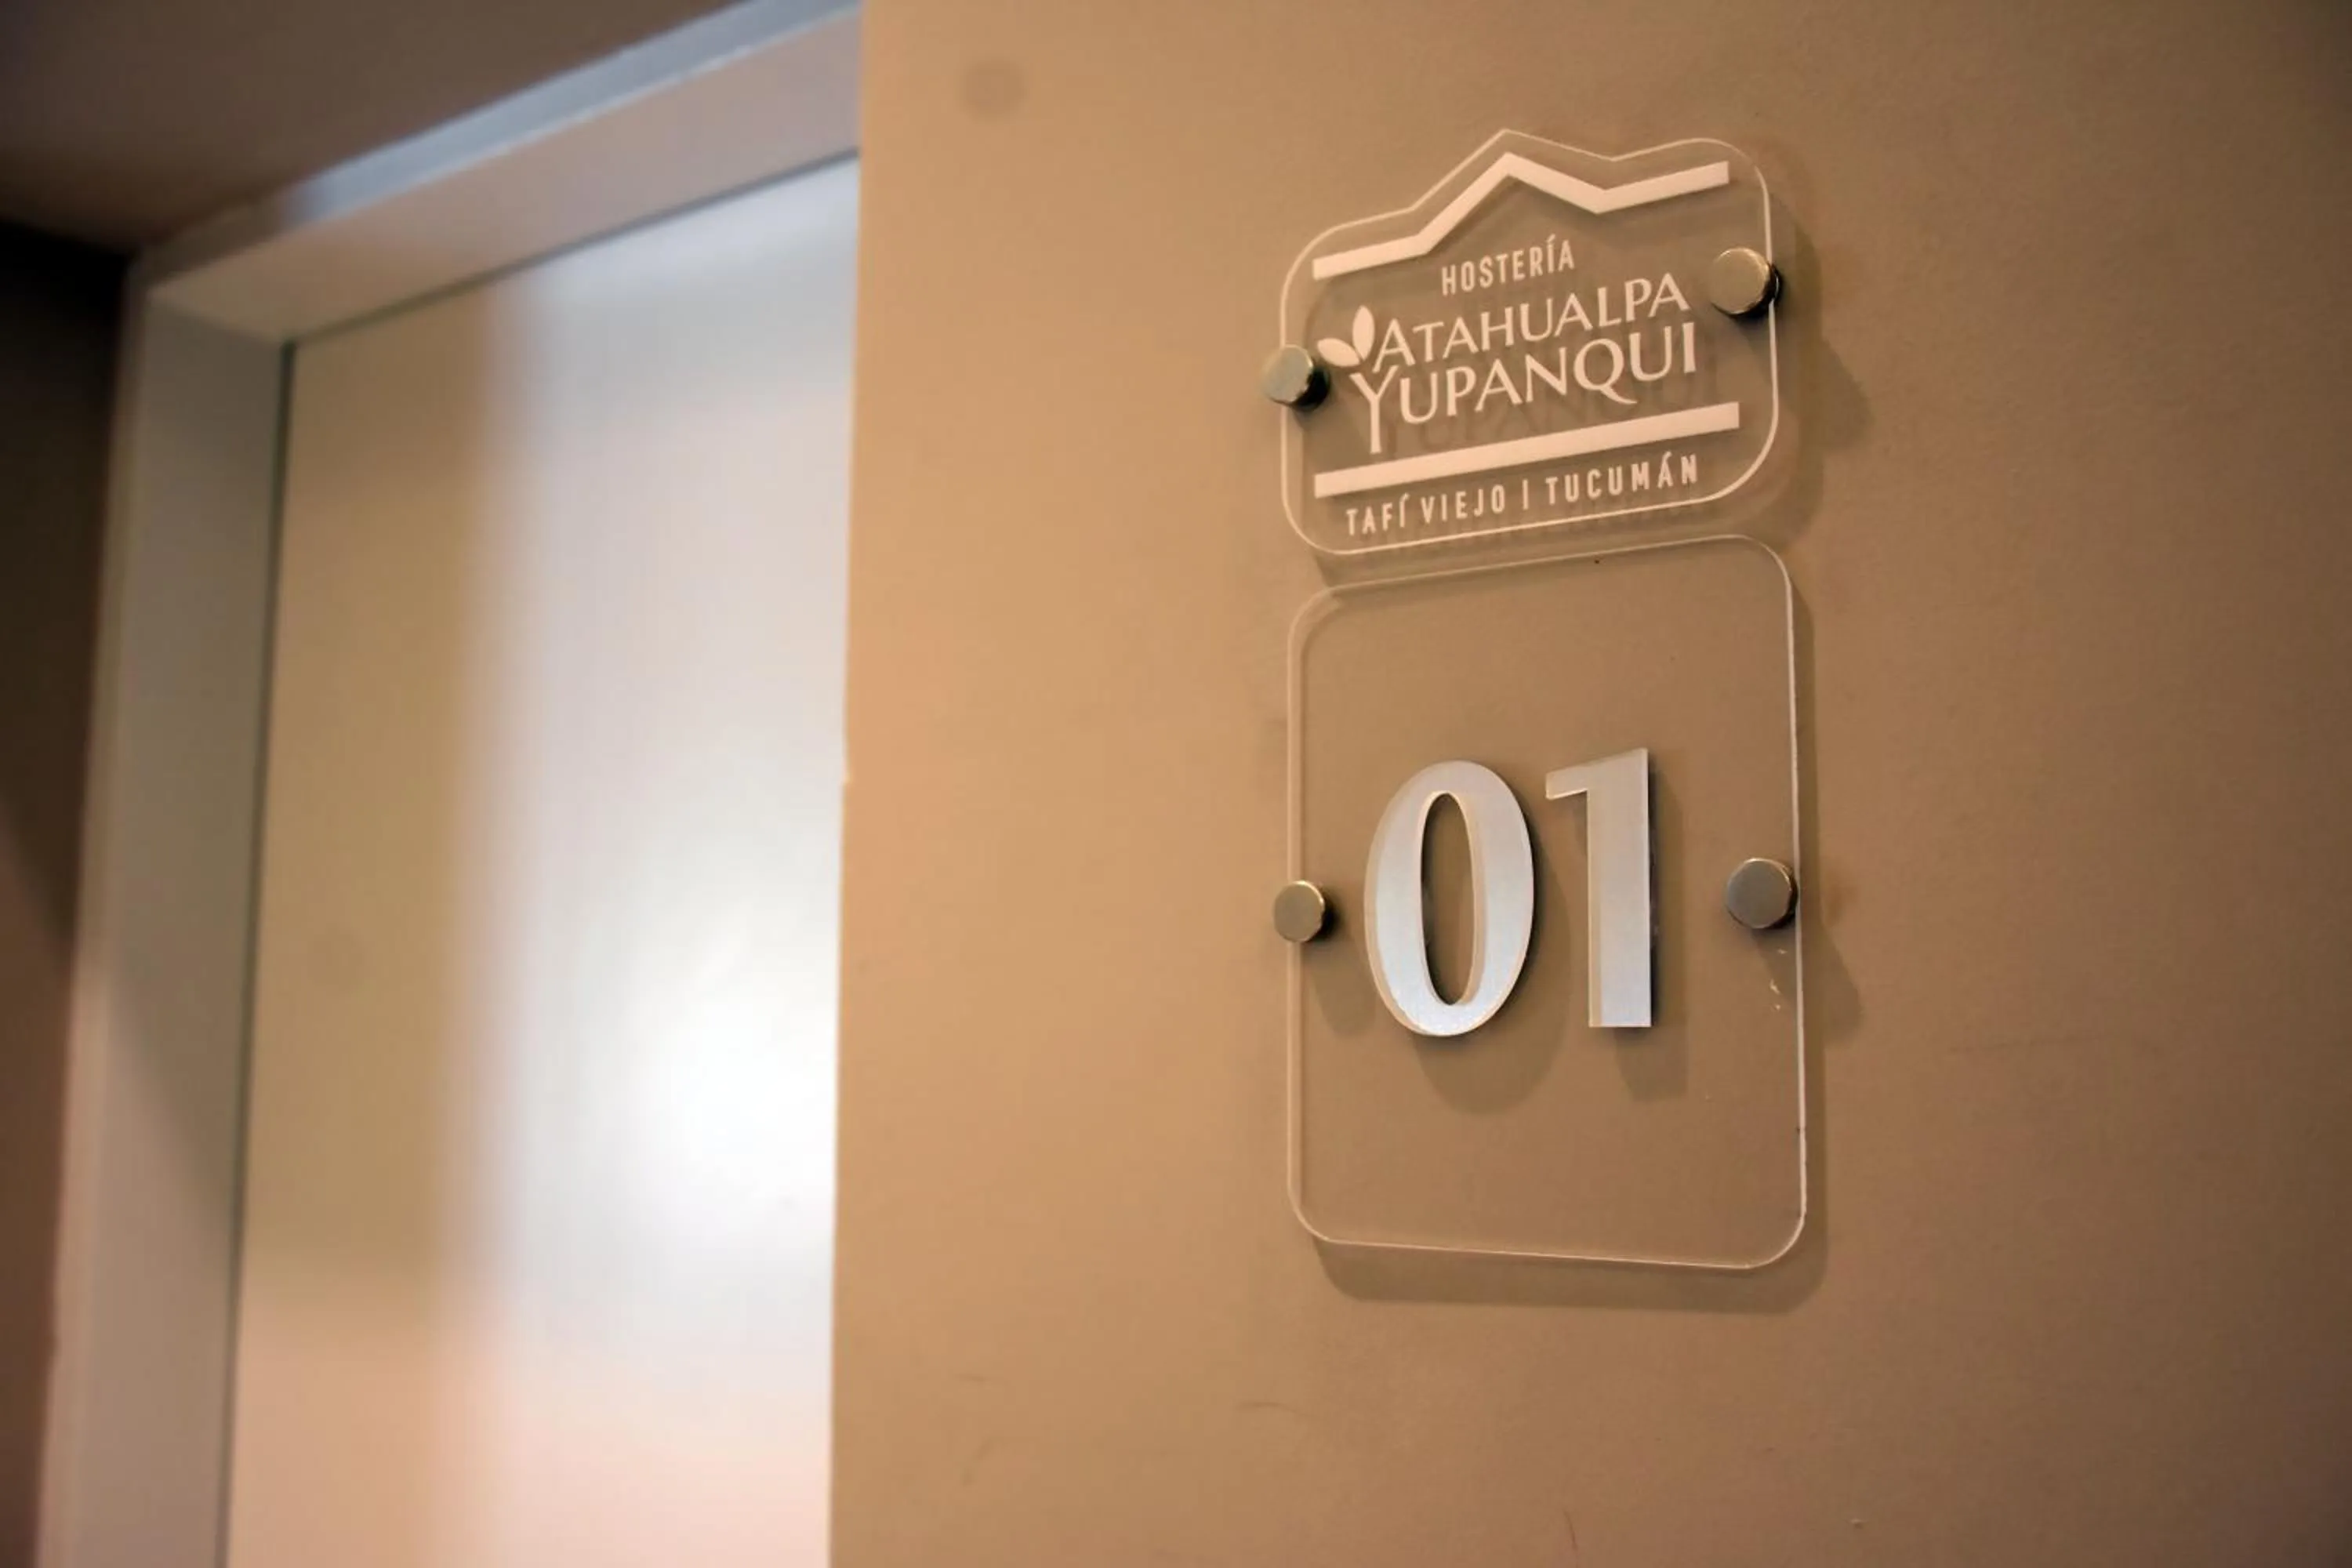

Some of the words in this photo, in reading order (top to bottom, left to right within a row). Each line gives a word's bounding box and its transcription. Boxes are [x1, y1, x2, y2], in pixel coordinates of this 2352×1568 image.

[1441, 234, 1575, 296] HOSTERÍA
[1372, 272, 1690, 373] ATAHUALPA
[1349, 322, 1697, 456] YUPANQUI
[1346, 494, 1409, 536] TAFÍ
[1420, 485, 1505, 524] VIEJO
[1545, 452, 1698, 504] TUCUMÁN
[1364, 747, 1652, 1036] 01
